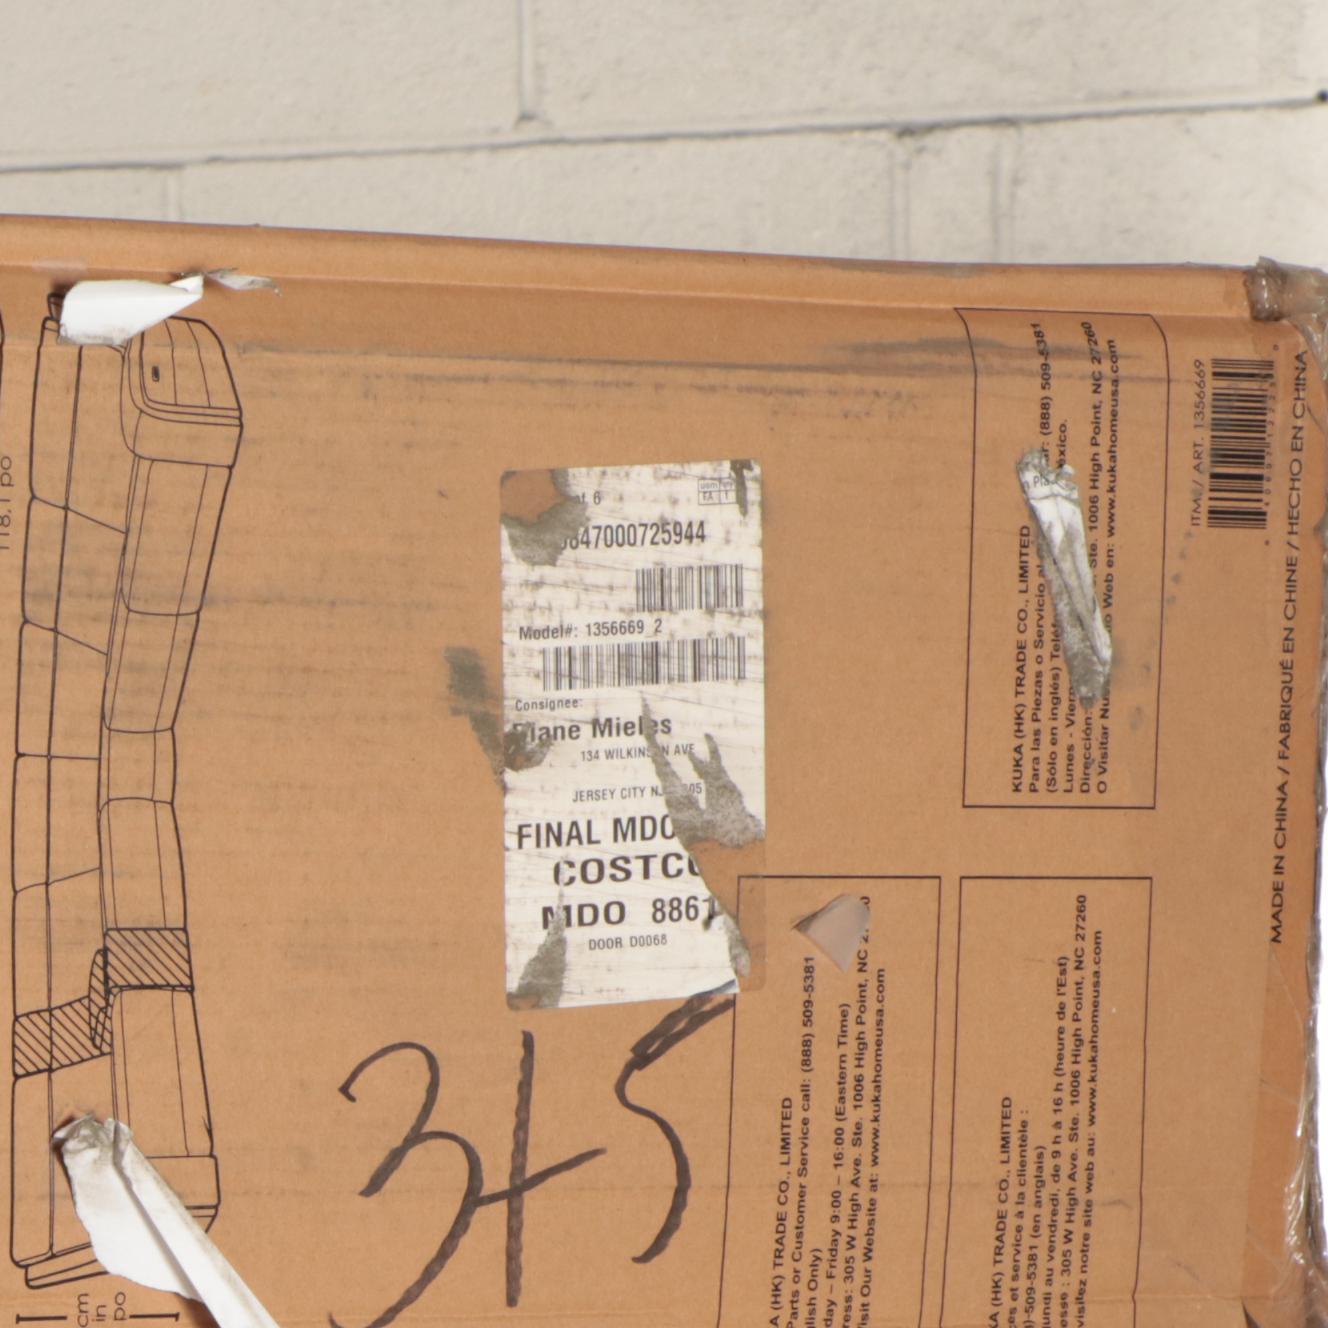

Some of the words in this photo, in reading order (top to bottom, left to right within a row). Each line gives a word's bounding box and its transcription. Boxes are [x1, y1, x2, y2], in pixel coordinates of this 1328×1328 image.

[1292, 351, 1308, 419] CHINA
[1291, 426, 1305, 452] EN
[1287, 459, 1302, 535] HECHO
[1283, 556, 1298, 620] CHINE
[519, 624, 578, 640] Model#:
[1282, 627, 1296, 653] EN
[515, 698, 583, 711] Consignee:
[1277, 660, 1294, 759] FABRIQUÉ
[581, 751, 600, 762] 134
[573, 789, 616, 803] JERSEY
[621, 787, 645, 799] CITY
[1273, 784, 1289, 849] CHINA
[517, 819, 600, 850] FINAL
[1273, 855, 1286, 875] IN
[1270, 881, 1285, 943] MADE
[589, 937, 622, 951] DOOR
[803, 957, 814, 1027] 509-5381
[801, 1033, 815, 1073] (888)
[800, 1079, 811, 1112] call:
[779, 1097, 793, 1166] LIMITED
[797, 1118, 810, 1177] Service
[777, 1171, 791, 1206] CO.,
[773, 1211, 787, 1269] TRADE
[792, 1184, 807, 1262] Customer
[771, 1275, 784, 1310] (HK)
[791, 1269, 801, 1284] or
[77, 1293, 89, 1327] cm
[93, 1305, 107, 1322] in
[113, 1292, 129, 1321] po
